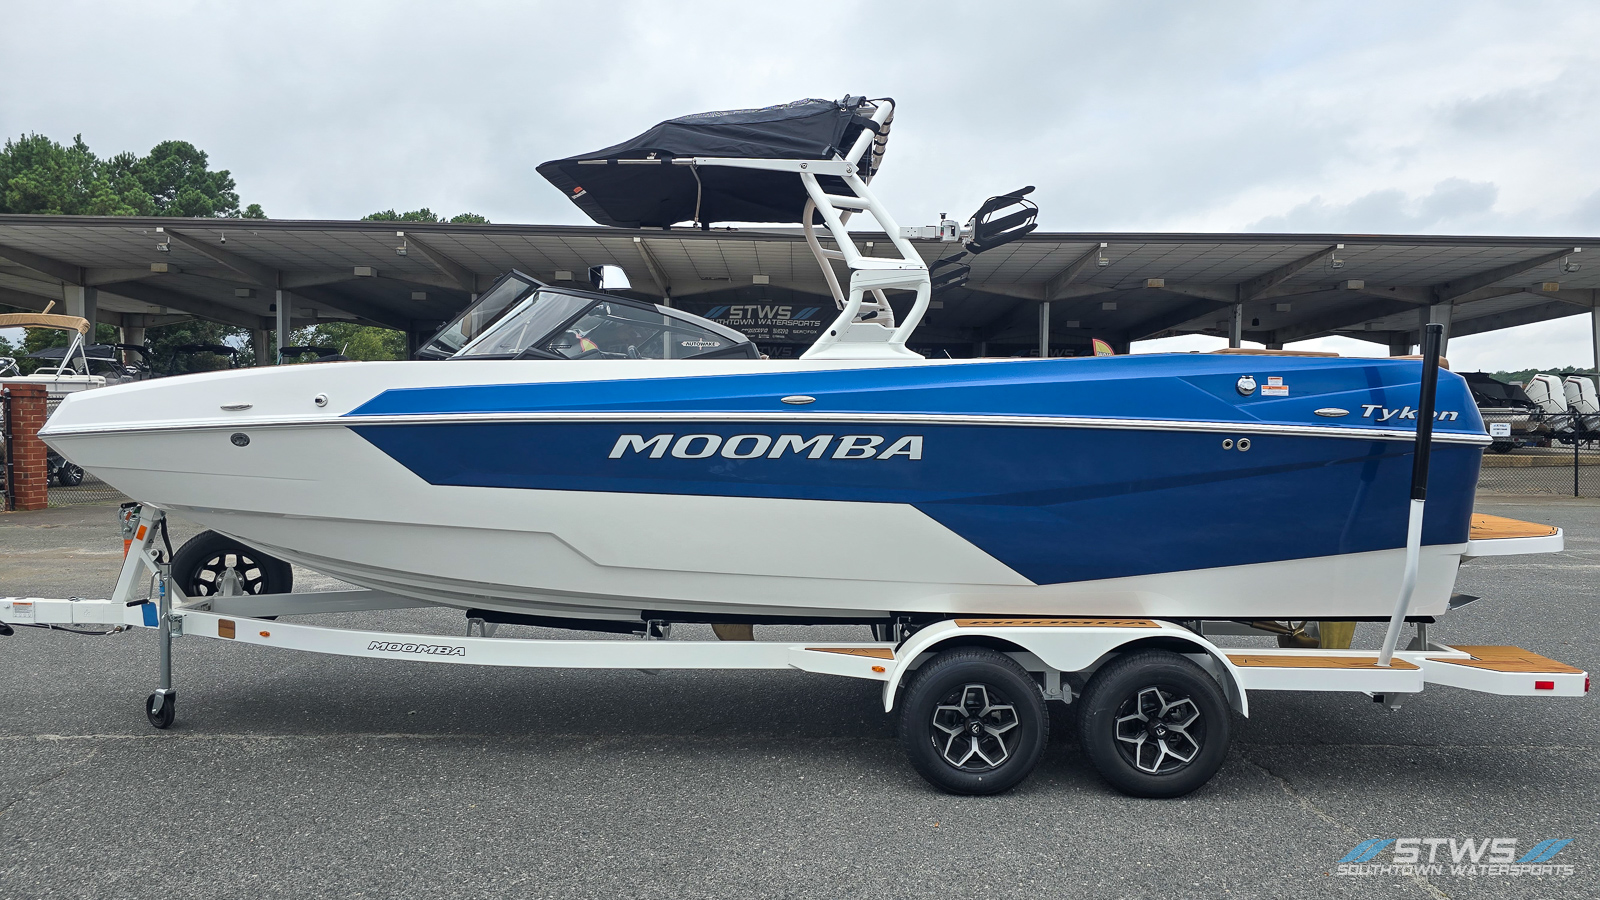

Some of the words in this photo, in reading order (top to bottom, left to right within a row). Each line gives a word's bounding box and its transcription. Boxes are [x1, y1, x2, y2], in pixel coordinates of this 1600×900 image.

[729, 305, 792, 320] STWS
[758, 319, 821, 327] WATERSPORTS
[757, 346, 793, 356] TWS
[1029, 348, 1075, 357] SWS
[1361, 404, 1459, 422] Tykn
[608, 434, 924, 460] MOOMBA
[367, 641, 465, 656] MOOMBA
